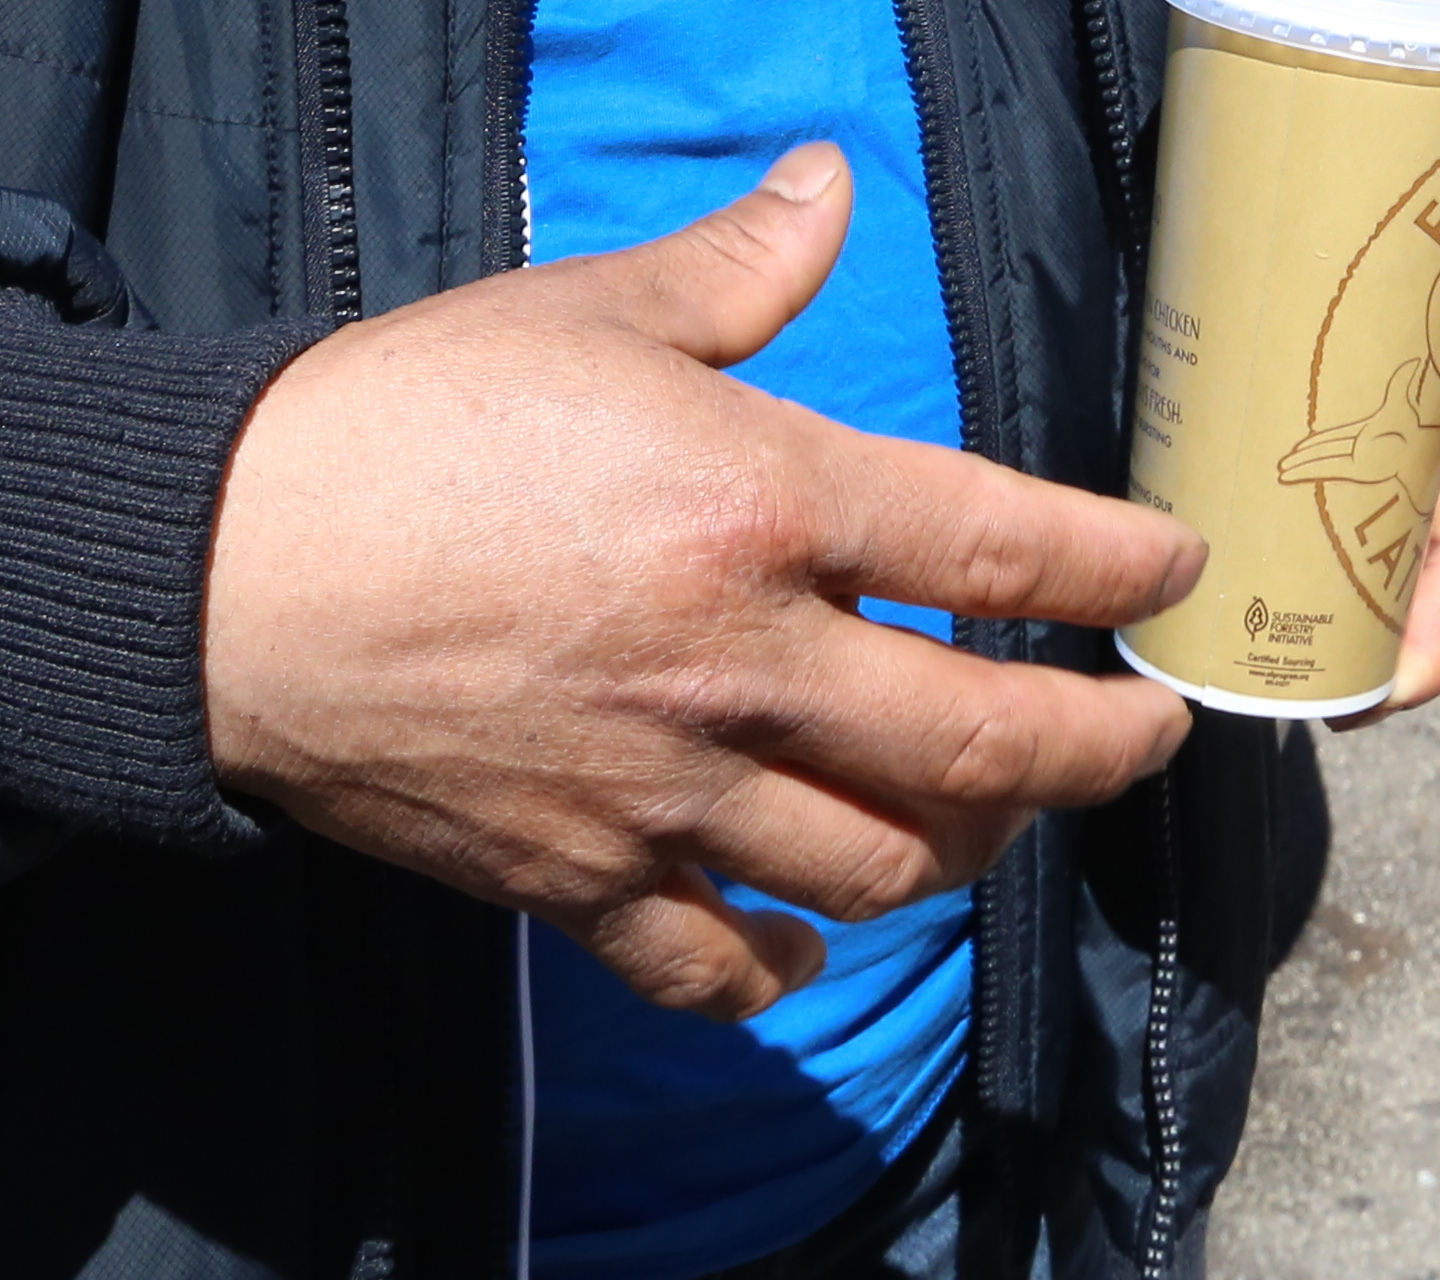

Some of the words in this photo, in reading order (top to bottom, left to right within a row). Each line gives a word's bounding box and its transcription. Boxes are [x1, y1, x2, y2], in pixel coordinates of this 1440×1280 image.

[1154, 299, 1201, 341] CHICKEN
[1173, 346, 1199, 367] AND
[1153, 495, 1174, 515] OUR
[1272, 611, 1334, 624] SUSTAINABLE
[1270, 622, 1316, 635] FORESTRY
[1268, 633, 1314, 646] INITIATIVE
[1247, 652, 1280, 665] Certified
[1282, 656, 1316, 668] Sourcing
